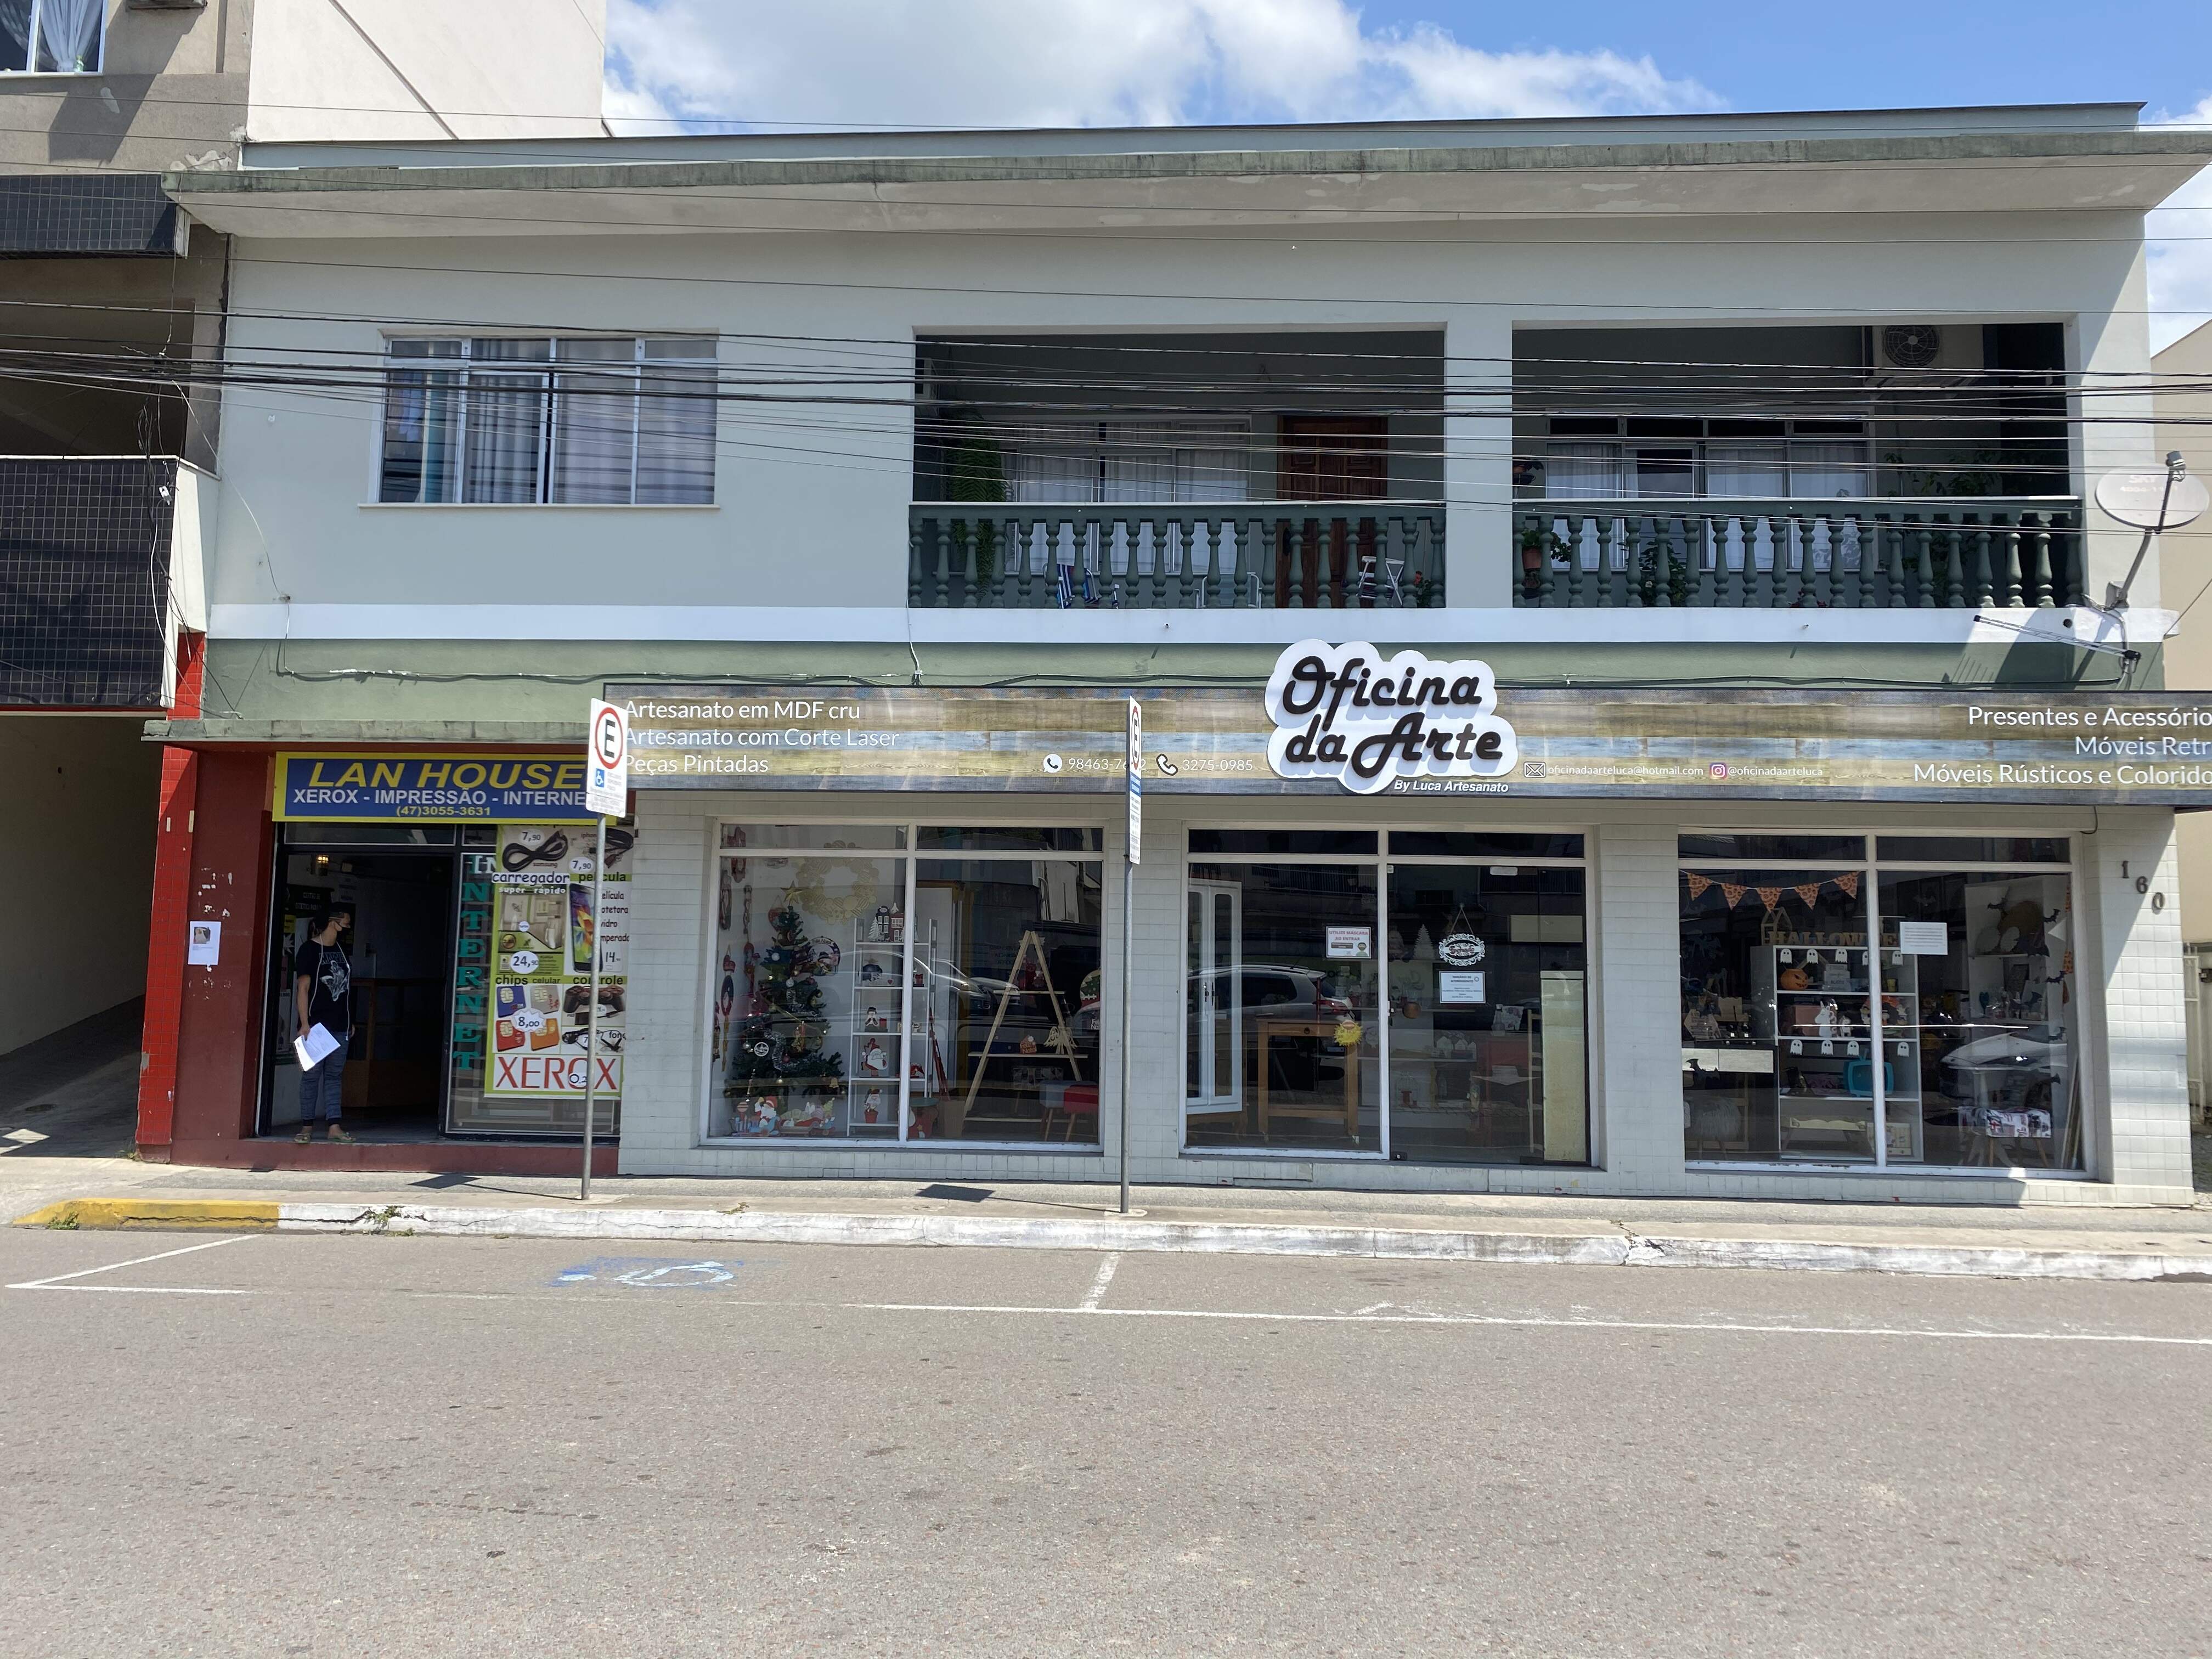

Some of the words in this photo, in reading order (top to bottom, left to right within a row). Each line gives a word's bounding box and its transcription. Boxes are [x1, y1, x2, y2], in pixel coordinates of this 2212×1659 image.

[1283, 656, 1482, 732] Oficina
[626, 701, 735, 719] Artesanato
[740, 706, 768, 719] em
[774, 701, 823, 719] MDF
[828, 706, 860, 719] cru
[1969, 706, 2079, 726] Presentes
[2084, 712, 2097, 726] e
[604, 718, 616, 758] E
[627, 728, 734, 746] Artesanato
[738, 733, 778, 746] com
[784, 728, 841, 746] Corte
[847, 729, 899, 746] Laser
[1285, 713, 1348, 763] da
[1352, 712, 1503, 778] Arte
[2075, 735, 2156, 755] Móveis
[684, 754, 769, 773] Pintadas
[1069, 758, 1146, 771] 98463-762
[1183, 759, 1253, 771] 3275-0985
[1548, 764, 1703, 776] oficinadaarteluca@hotmail.com
[309, 762, 405, 788] LAN
[417, 763, 586, 789] HOUSE
[1728, 765, 1823, 777] @oficinadaarteluca
[1914, 763, 1993, 783] Móveis
[1999, 763, 2093, 785] Rústicos
[2098, 770, 2112, 785] e
[1394, 780, 1410, 792] By
[1413, 781, 1442, 792] Luca
[1444, 781, 1509, 792] Artesanato
[293, 789, 359, 804] XEROX
[375, 787, 487, 805] IMPRESSÃO
[504, 791, 586, 805] INTERNE
[396, 805, 490, 816] (47)3055-3631
[522, 832, 541, 842] 7,90
[581, 832, 596, 840] iphon
[572, 860, 591, 871] 7,90
[493, 871, 569, 886] carregador
[499, 885, 526, 894] super
[534, 885, 566, 894] rápido
[602, 890, 624, 900] elícula
[1768, 931, 1898, 946] HALLOWE
[513, 956, 539, 968] 24,90
[495, 975, 528, 986] chips
[518, 1016, 539, 1028] 8,00
